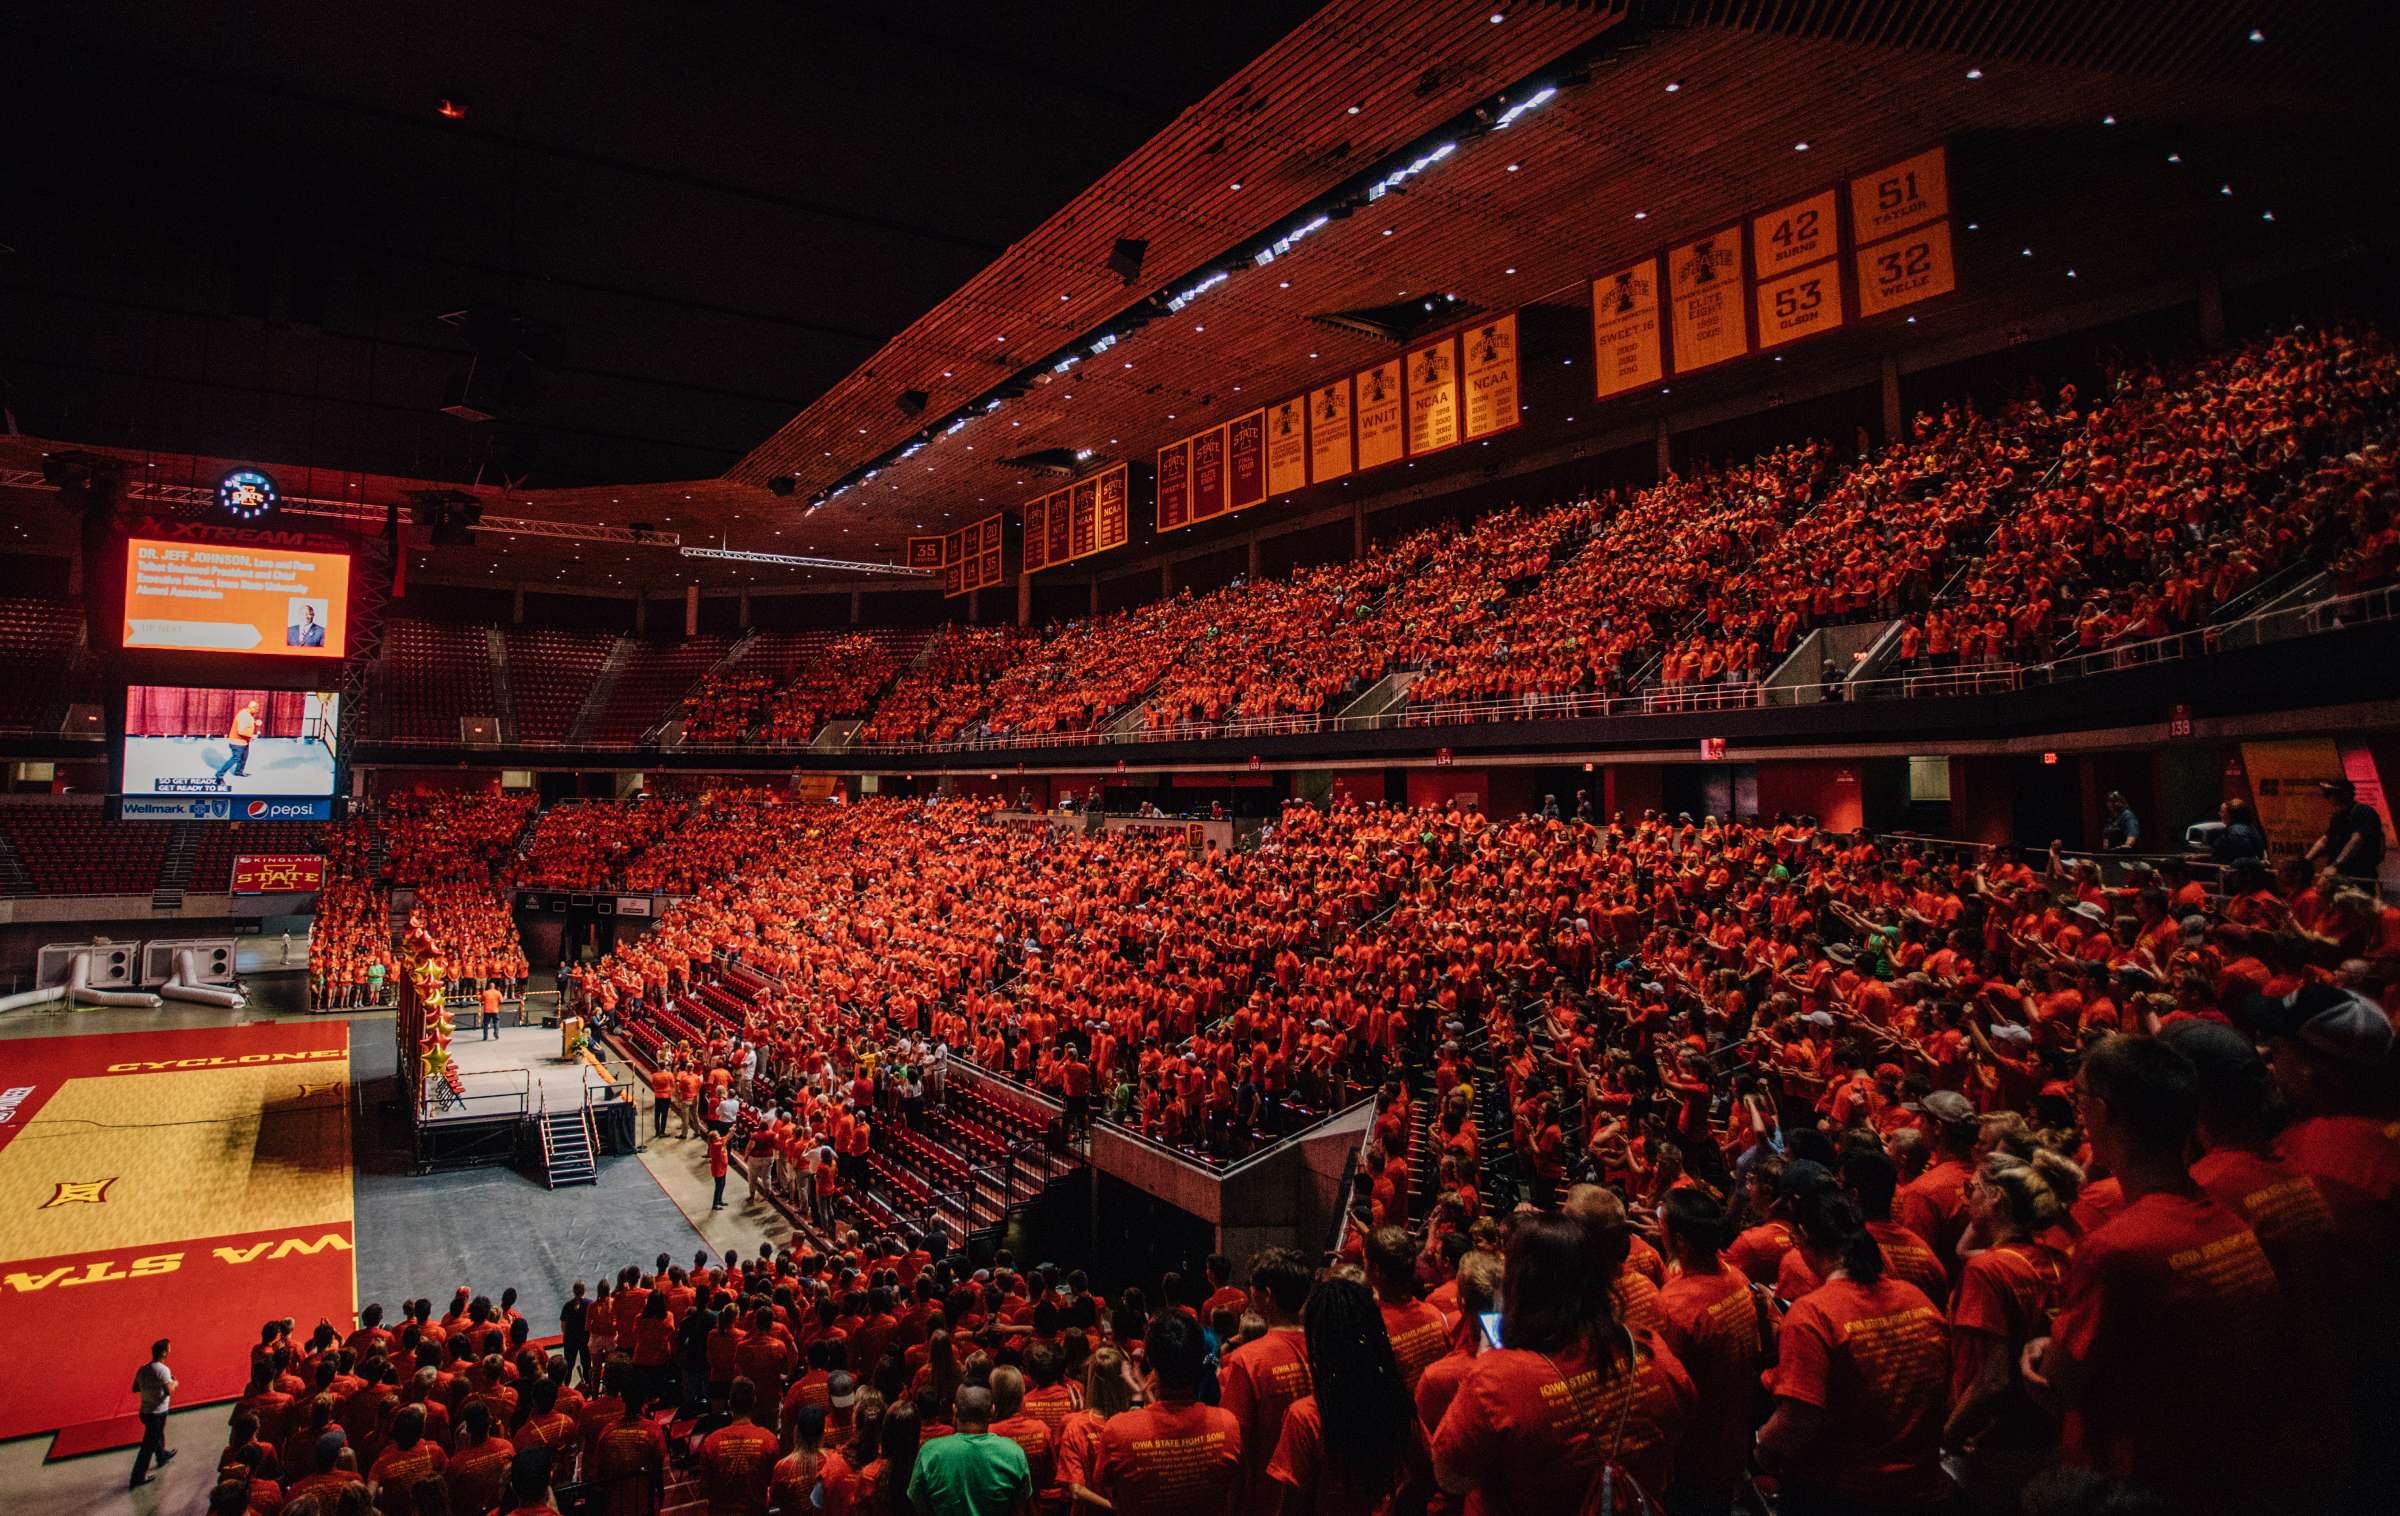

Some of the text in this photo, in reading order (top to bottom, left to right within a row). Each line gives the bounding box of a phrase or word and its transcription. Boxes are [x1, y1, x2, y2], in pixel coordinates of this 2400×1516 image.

[1879, 171, 1919, 211] 51
[1872, 200, 1927, 226] TAYLOR
[1772, 210, 1818, 246] 42
[1878, 242, 1931, 286] 32
[1882, 275, 1929, 299] WELLE
[1776, 278, 1821, 318] 53
[1689, 303, 1721, 320] EIGHT
[1780, 311, 1818, 330] OLSON
[1600, 325, 1640, 345] SWEET
[1474, 371, 1508, 391] NCAA
[1416, 392, 1448, 411] NCAA
[1362, 407, 1398, 429] WNIT
[1104, 480, 1122, 496] STATE
[1104, 504, 1121, 517] NCAA
[169, 522, 306, 546] XTREAM
[138, 548, 158, 559] DR.
[161, 550, 189, 561] JEFF
[192, 552, 252, 567] JOHNSON,
[918, 544, 936, 557] 35
[124, 803, 313, 817] Wellmark pepsi
[237, 872, 319, 884] STATE
[0, 1252, 185, 1293] STA
[1540, 1381, 1568, 1397] IOWA
[1132, 1440, 1153, 1449] IOWA
[1155, 1439, 1179, 1448] STATE
[1206, 1431, 1225, 1442] SONG
